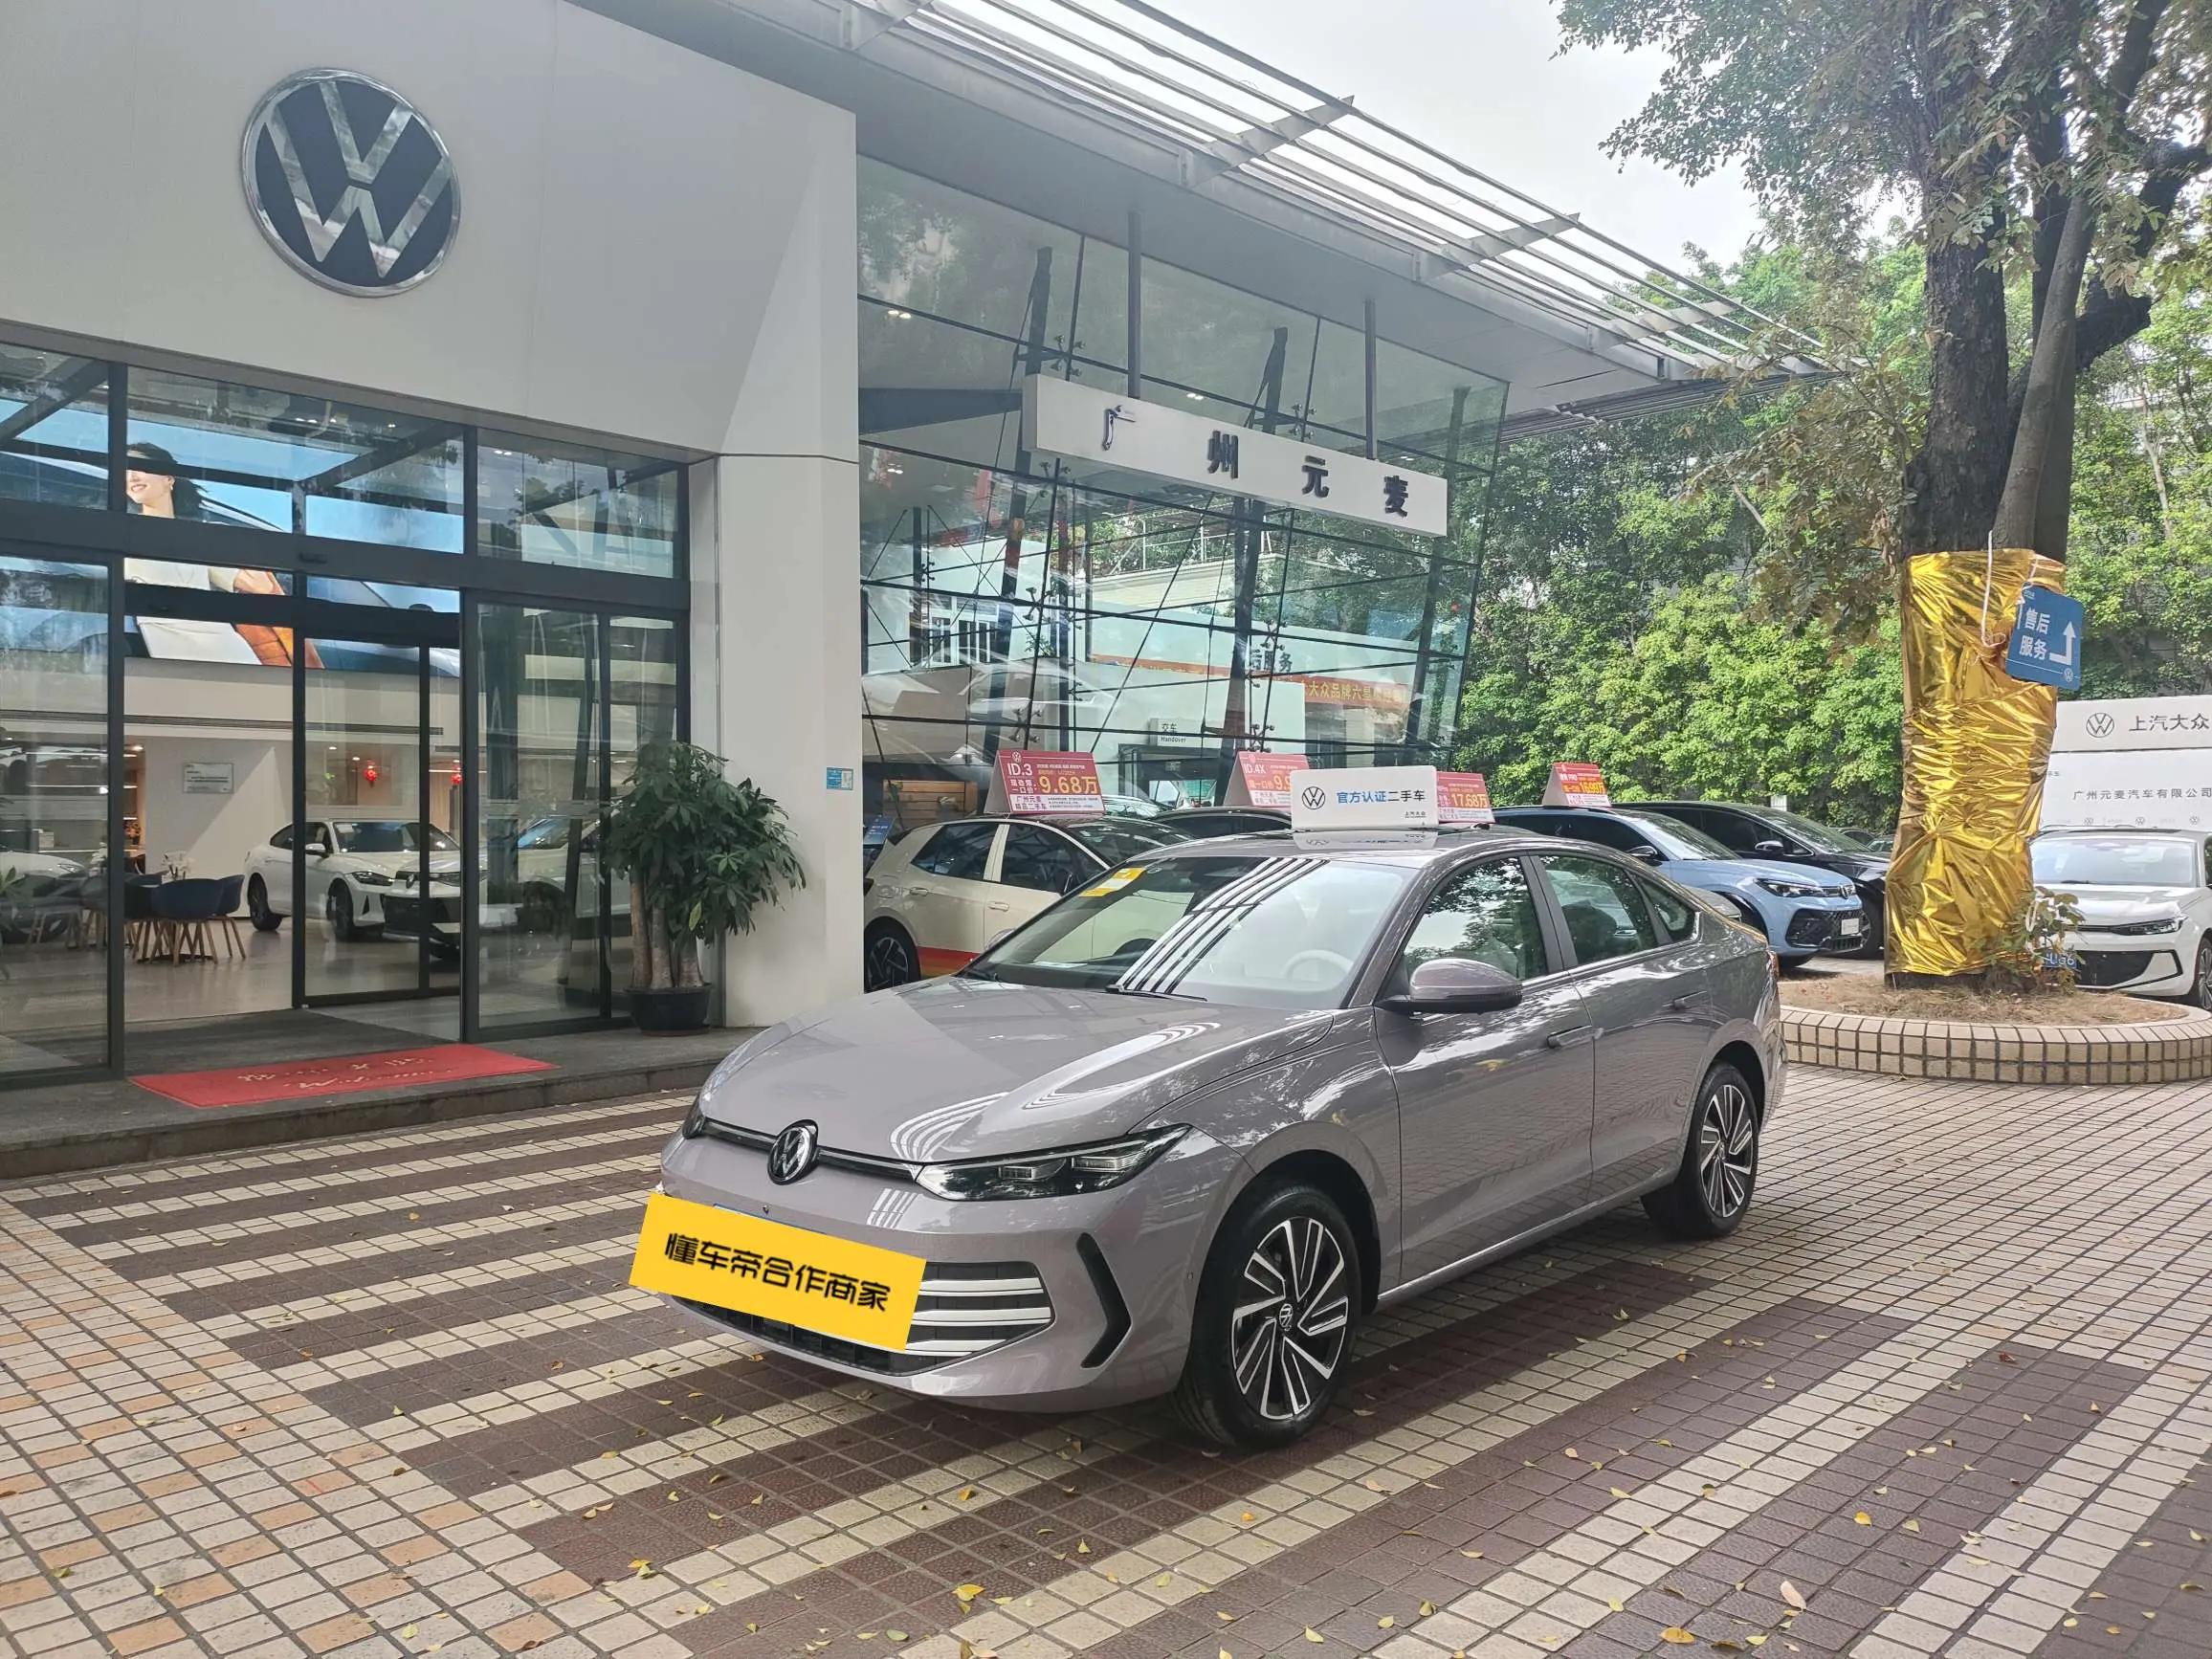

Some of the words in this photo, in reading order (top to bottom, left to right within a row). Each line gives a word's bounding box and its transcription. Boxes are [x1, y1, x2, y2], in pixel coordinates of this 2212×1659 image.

[1102, 405, 1409, 518] 广州元麦
[2024, 608, 2050, 635] 售后
[2019, 634, 2047, 661] 服务
[2129, 713, 2210, 732] 上汽大众
[1007, 763, 1033, 776] ID.3
[1243, 763, 1267, 774] ID.4X
[1038, 775, 1097, 794] 9.68万
[2072, 786, 2212, 801] 广州元麦汽车有限公司
[1337, 789, 1426, 804] 官方认证二手车
